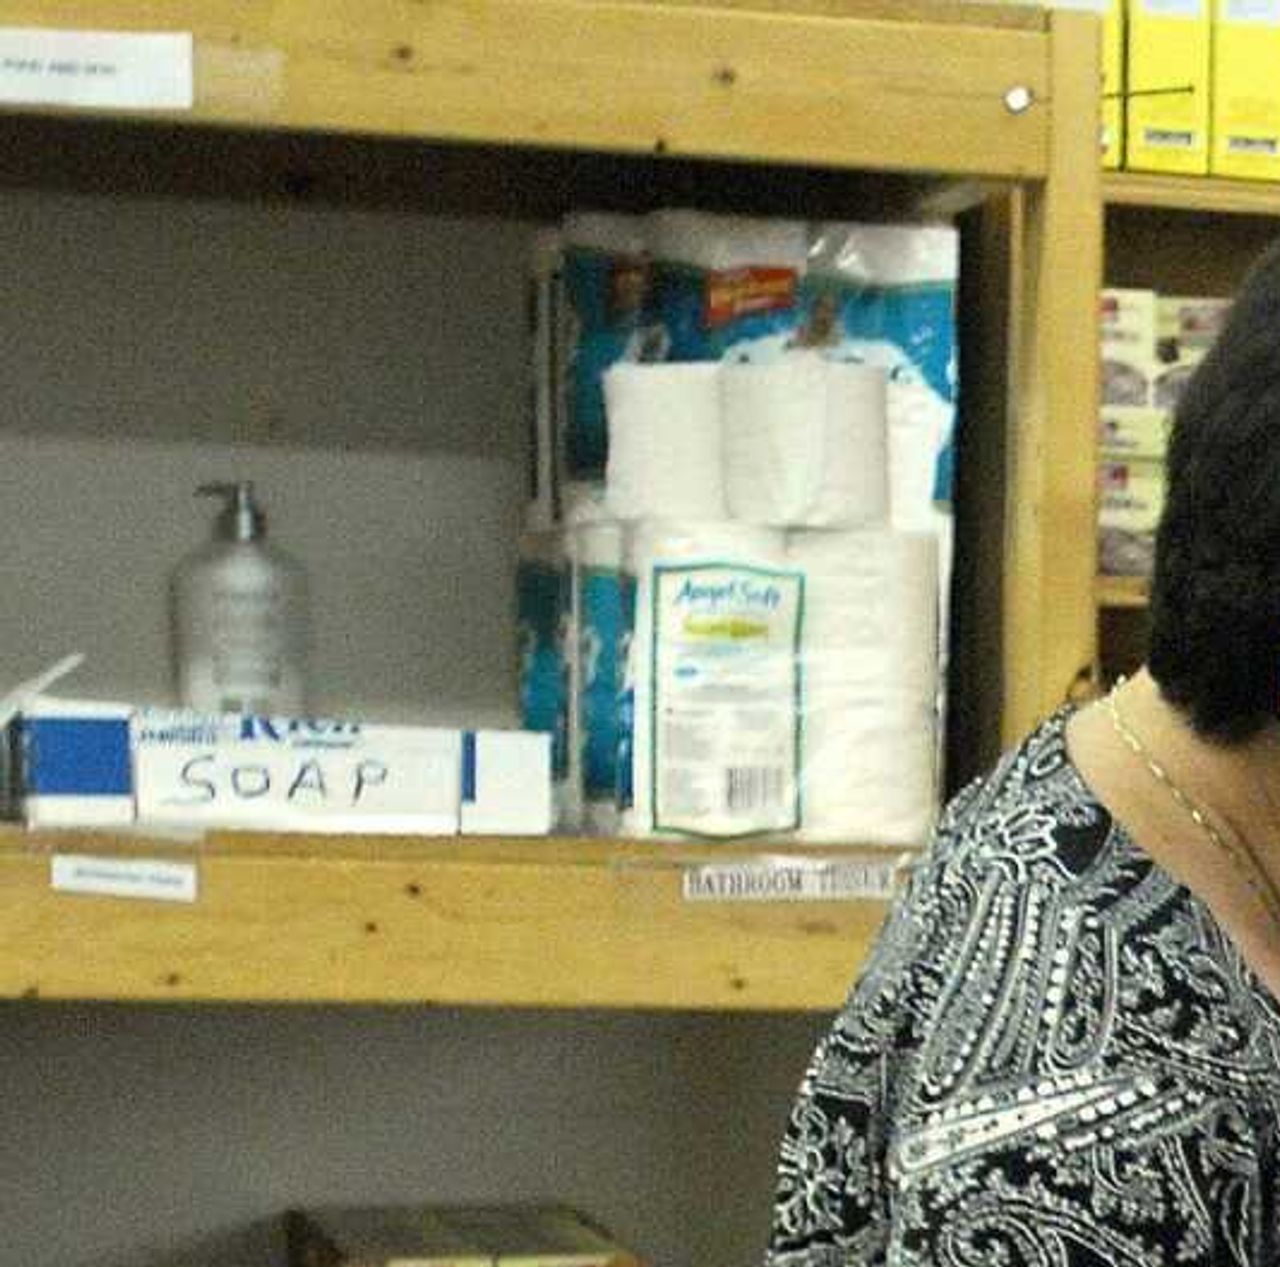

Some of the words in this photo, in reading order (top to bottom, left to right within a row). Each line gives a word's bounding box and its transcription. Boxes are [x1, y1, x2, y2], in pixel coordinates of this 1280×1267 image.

[673, 578, 735, 613] Angel
[740, 579, 782, 611] Soft
[181, 754, 388, 806] SOAP
